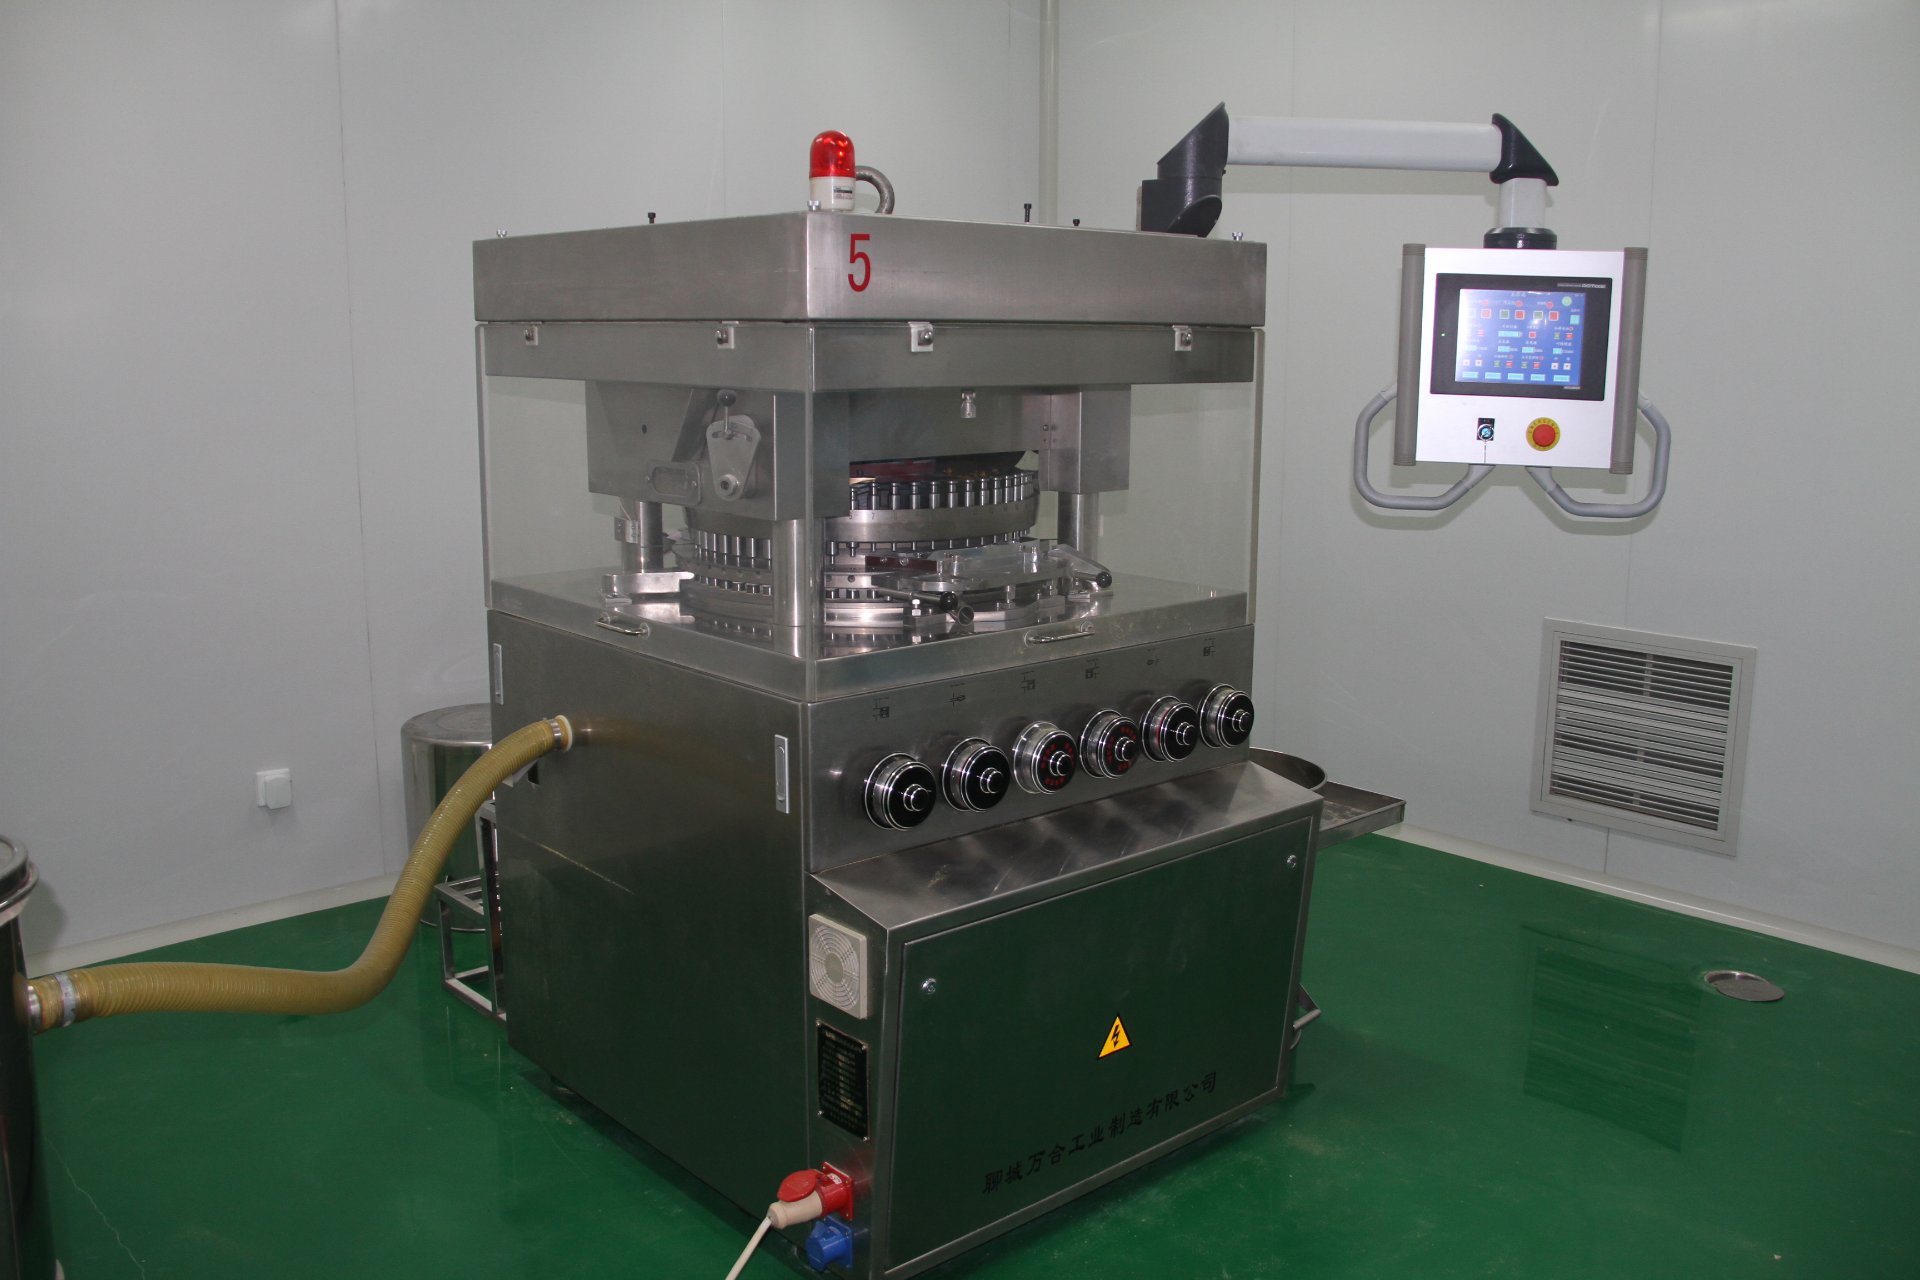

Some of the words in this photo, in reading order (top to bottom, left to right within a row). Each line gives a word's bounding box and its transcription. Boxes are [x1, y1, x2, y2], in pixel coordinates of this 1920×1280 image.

[848, 233, 871, 292] 5
[982, 1071, 1217, 1194] 聊城万合工业制造有限公司
